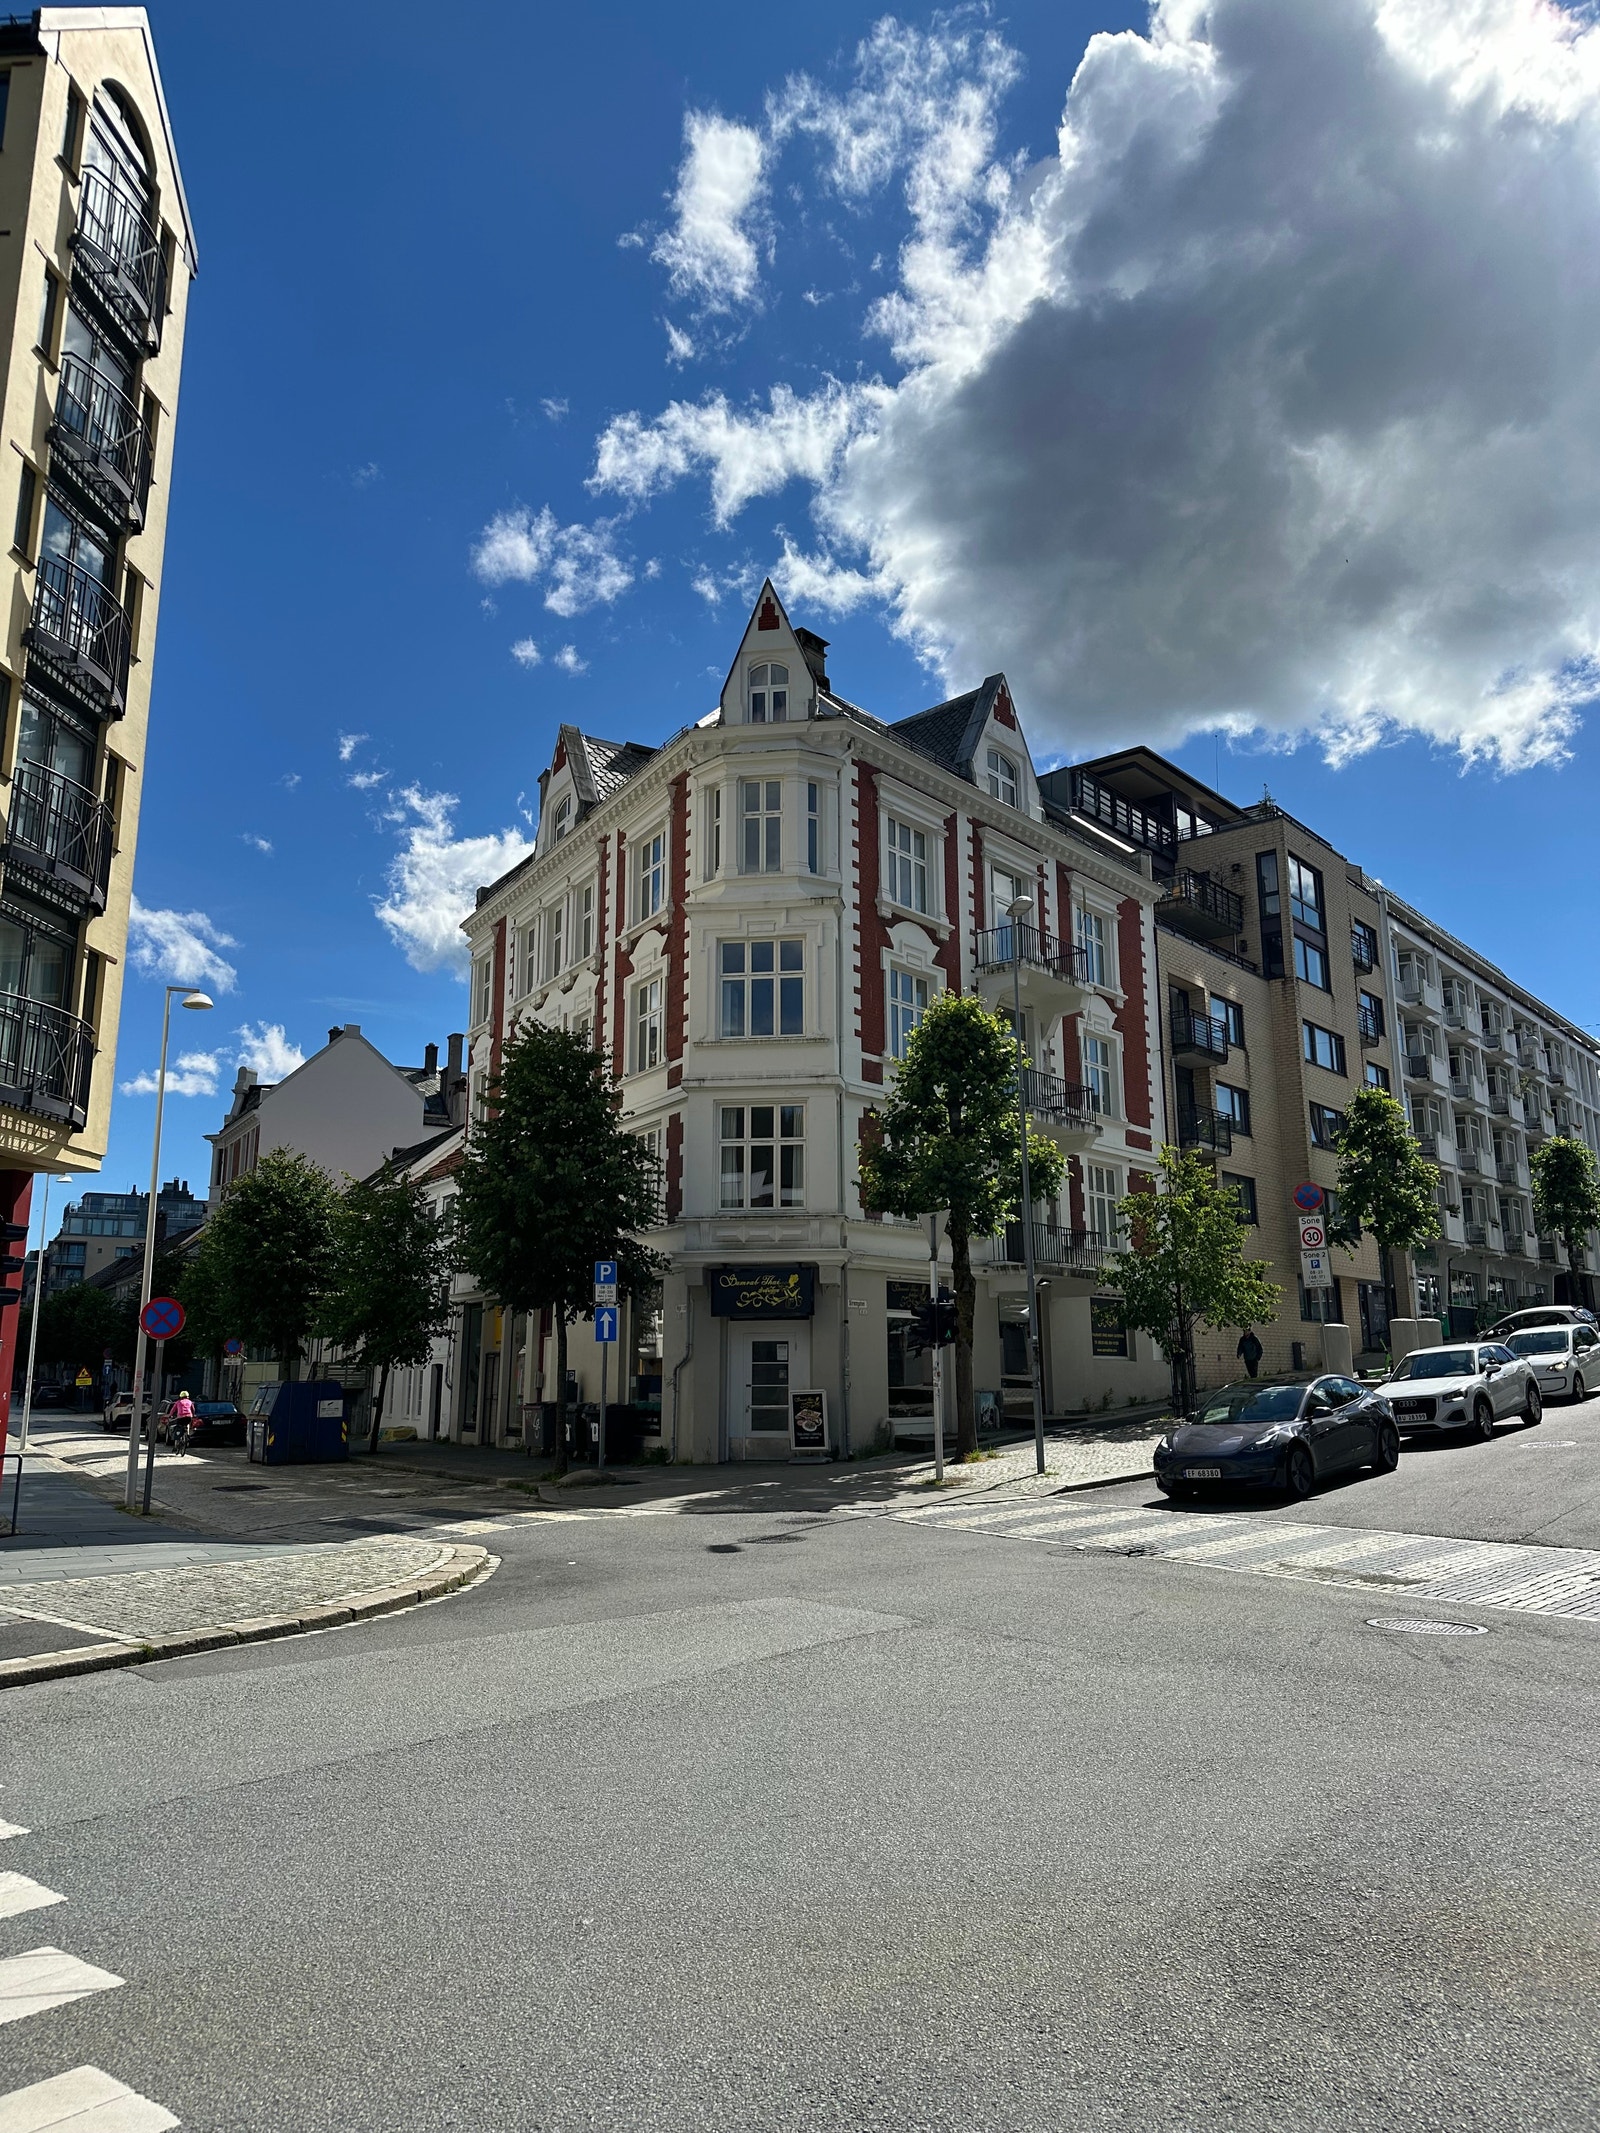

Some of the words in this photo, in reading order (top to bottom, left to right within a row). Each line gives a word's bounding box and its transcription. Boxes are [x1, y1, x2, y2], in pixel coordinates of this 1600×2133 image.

[1301, 1217, 1320, 1225] Sone
[1305, 1231, 1319, 1242] 30
[1312, 1260, 1319, 1268] P
[600, 1264, 612, 1281] P
